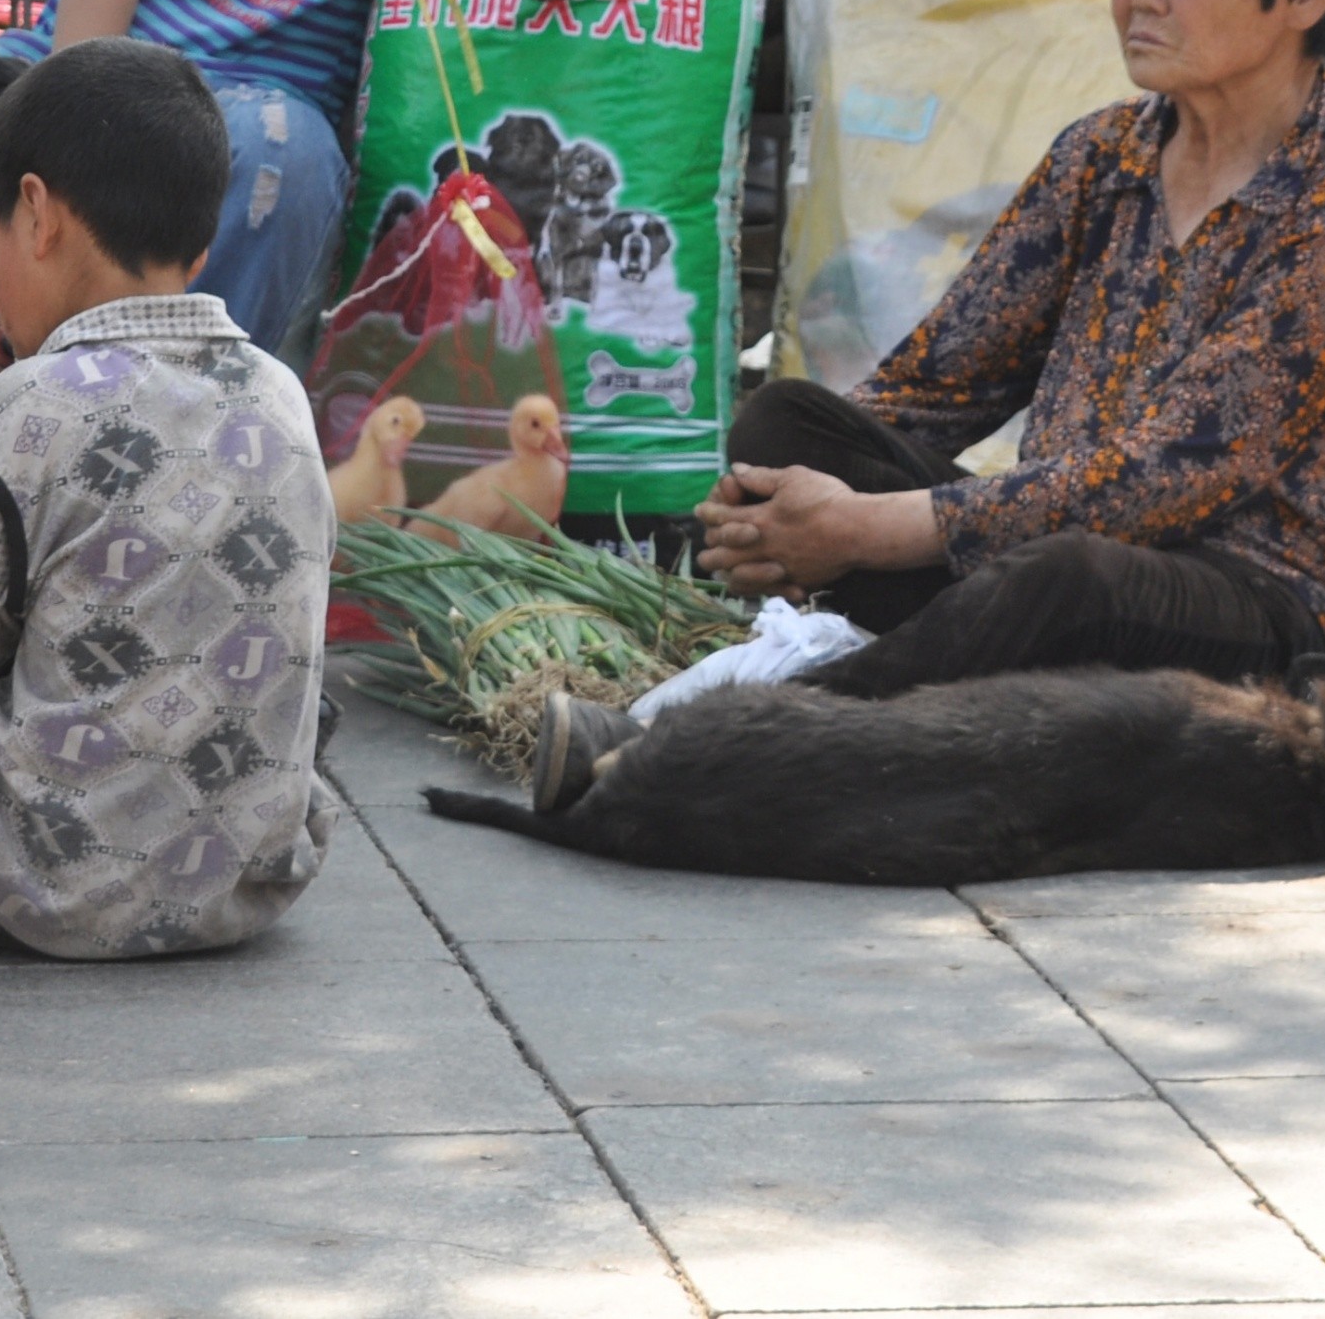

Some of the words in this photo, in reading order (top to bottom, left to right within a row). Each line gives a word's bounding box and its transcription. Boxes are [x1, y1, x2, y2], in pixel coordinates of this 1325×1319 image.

[238, 532, 279, 571] X
[79, 639, 129, 675] X
[227, 635, 271, 680] J
